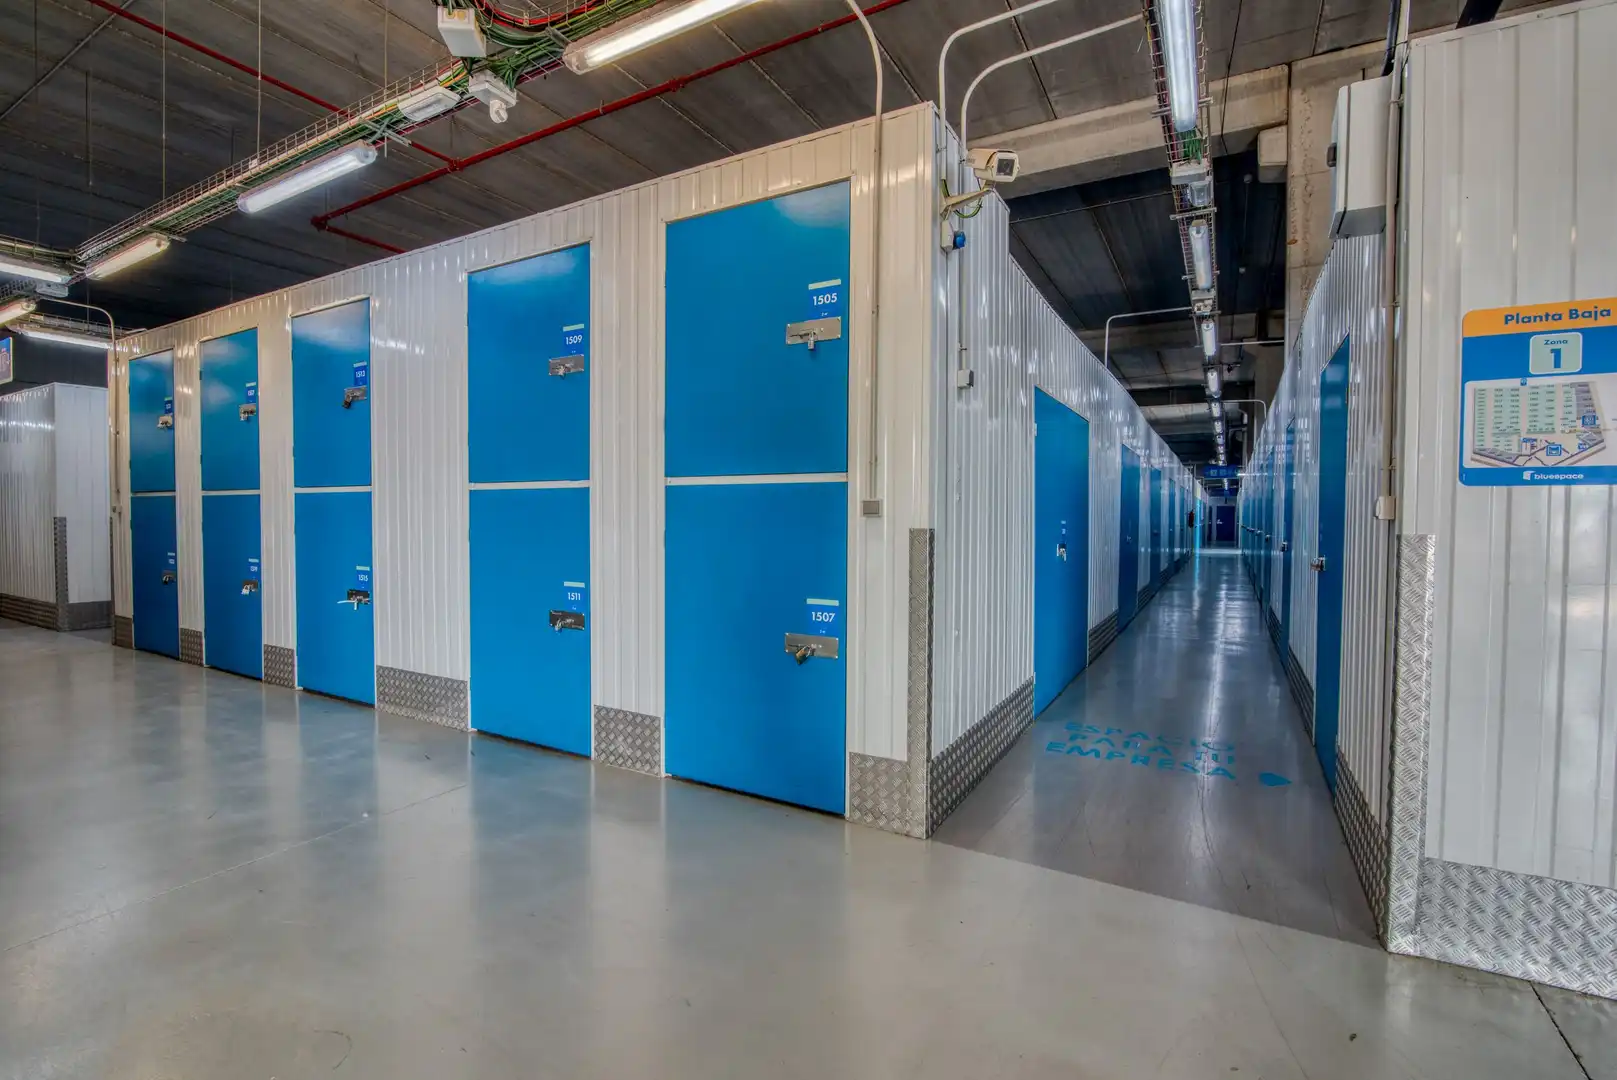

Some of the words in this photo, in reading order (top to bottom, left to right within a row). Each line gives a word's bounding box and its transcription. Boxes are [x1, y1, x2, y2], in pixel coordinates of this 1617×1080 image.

[812, 292, 838, 306] 1505
[1504, 311, 1562, 325] Planta
[1568, 306, 1612, 321] Baja
[565, 334, 583, 345] 1509
[1543, 338, 1568, 346] Zona
[1550, 348, 1562, 369] 1
[1534, 472, 1584, 480] bluespace
[567, 592, 581, 601] 1511
[811, 611, 836, 622] 1507
[1045, 741, 1236, 780] EMPRESA
